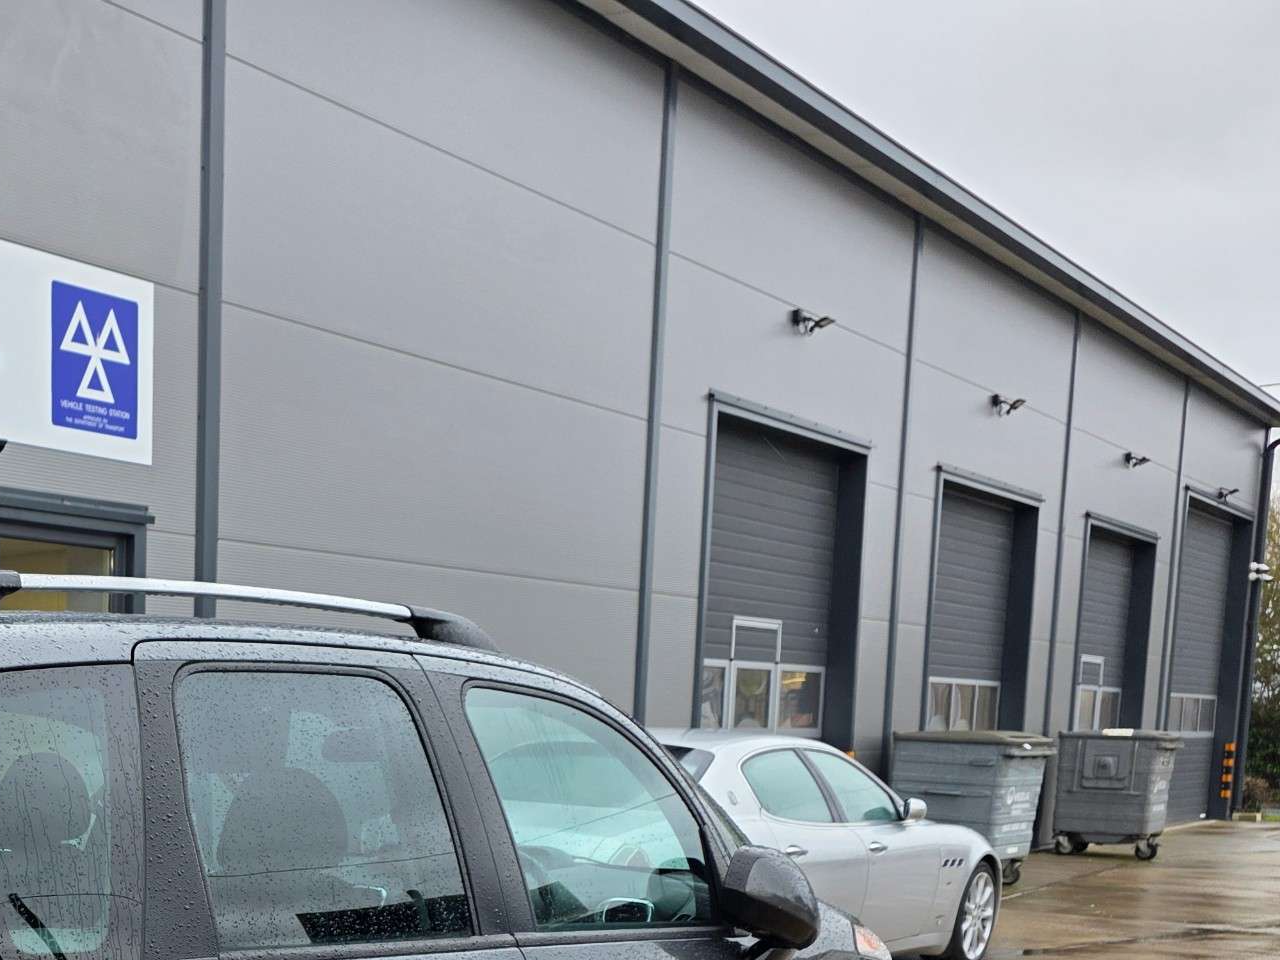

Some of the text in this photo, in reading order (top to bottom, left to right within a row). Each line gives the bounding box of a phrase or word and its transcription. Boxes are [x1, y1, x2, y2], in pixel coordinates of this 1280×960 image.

[60, 399, 83, 411] VEHICLE
[85, 403, 108, 416] TESTING
[108, 408, 131, 420] STATION
